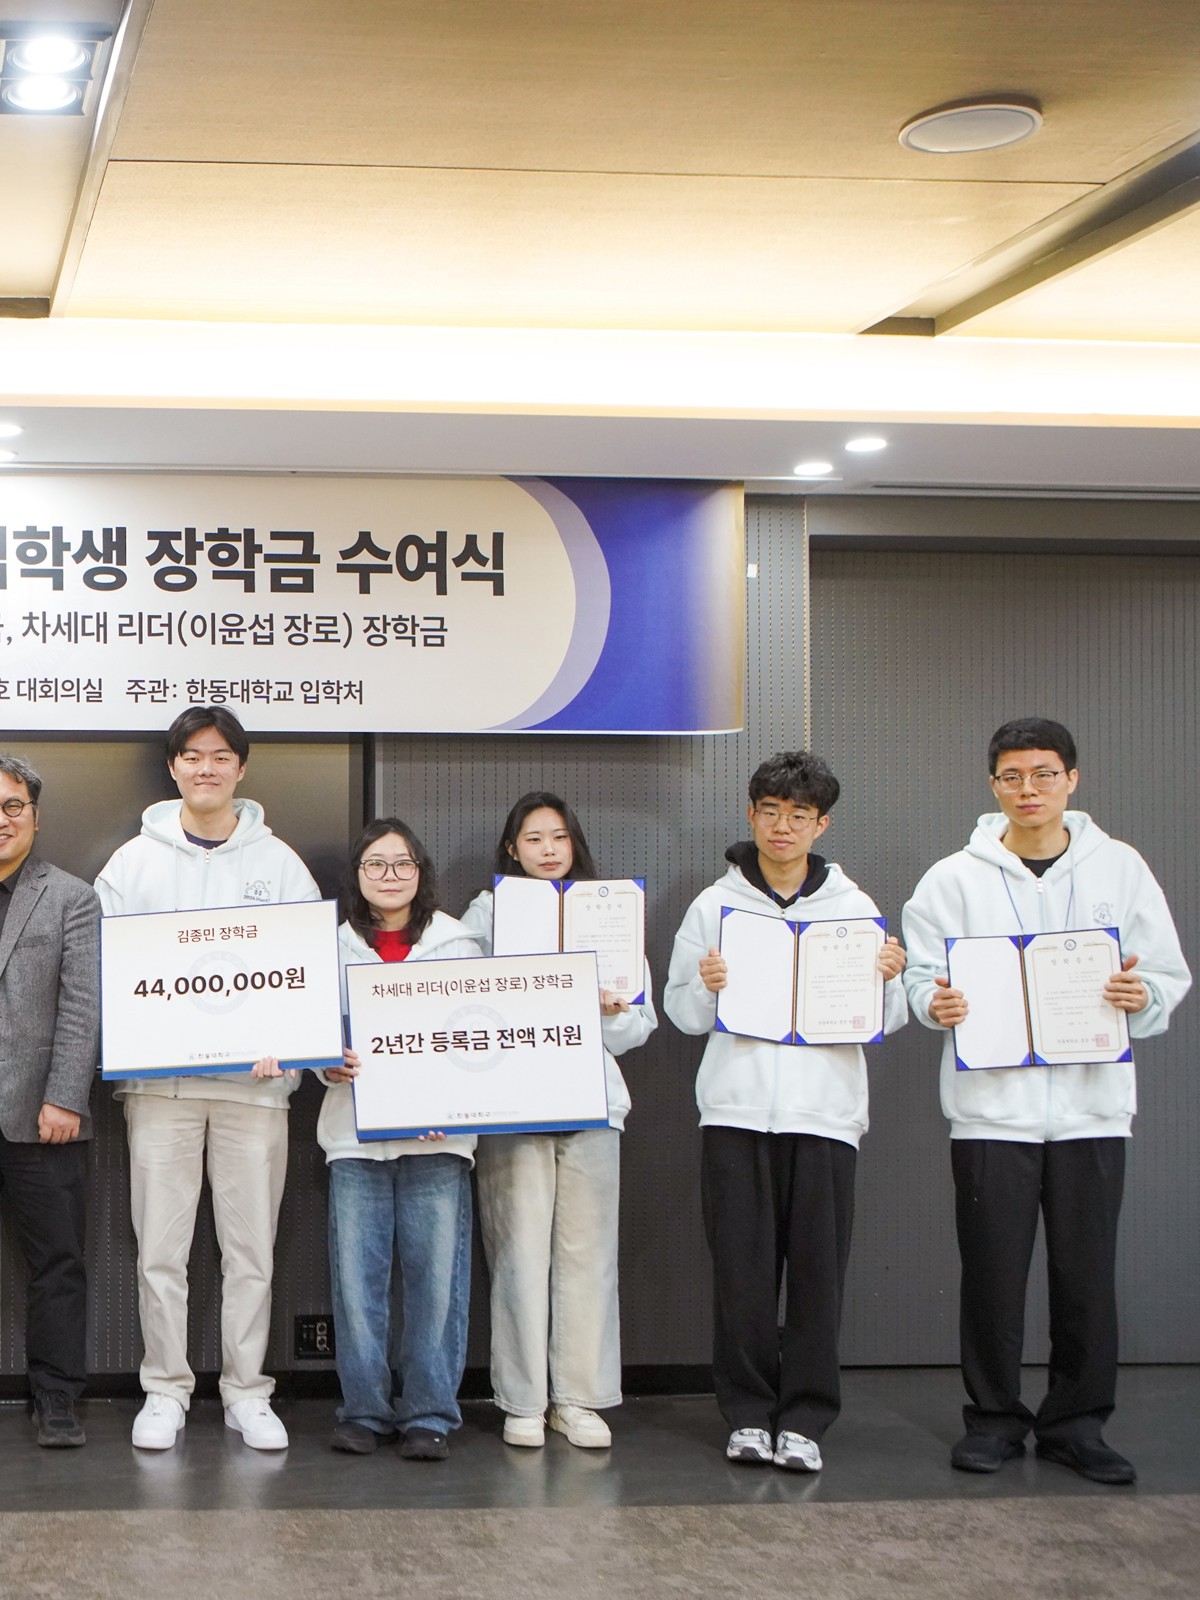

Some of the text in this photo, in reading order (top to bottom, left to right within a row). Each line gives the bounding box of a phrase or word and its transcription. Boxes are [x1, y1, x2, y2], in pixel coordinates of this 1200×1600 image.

[146, 528, 320, 593] 장학금
[337, 531, 504, 596] 수여식
[22, 611, 107, 644] 차세대
[119, 610, 274, 647] 리더(이윤섭
[284, 612, 352, 649] 장로)
[363, 614, 448, 647] 장학금
[17, 678, 102, 702] 대회의실
[126, 679, 177, 703] 주관:
[186, 679, 294, 704] 한동대학교
[300, 680, 362, 705] 입학처
[178, 925, 257, 943] 김종민 장학금
[134, 966, 306, 1000] 44,000,000원
[372, 974, 573, 998] 차세대 리더(이윤섭 장로) 장학금
[372, 1025, 582, 1054] 2년간 등록금 전액 지원
